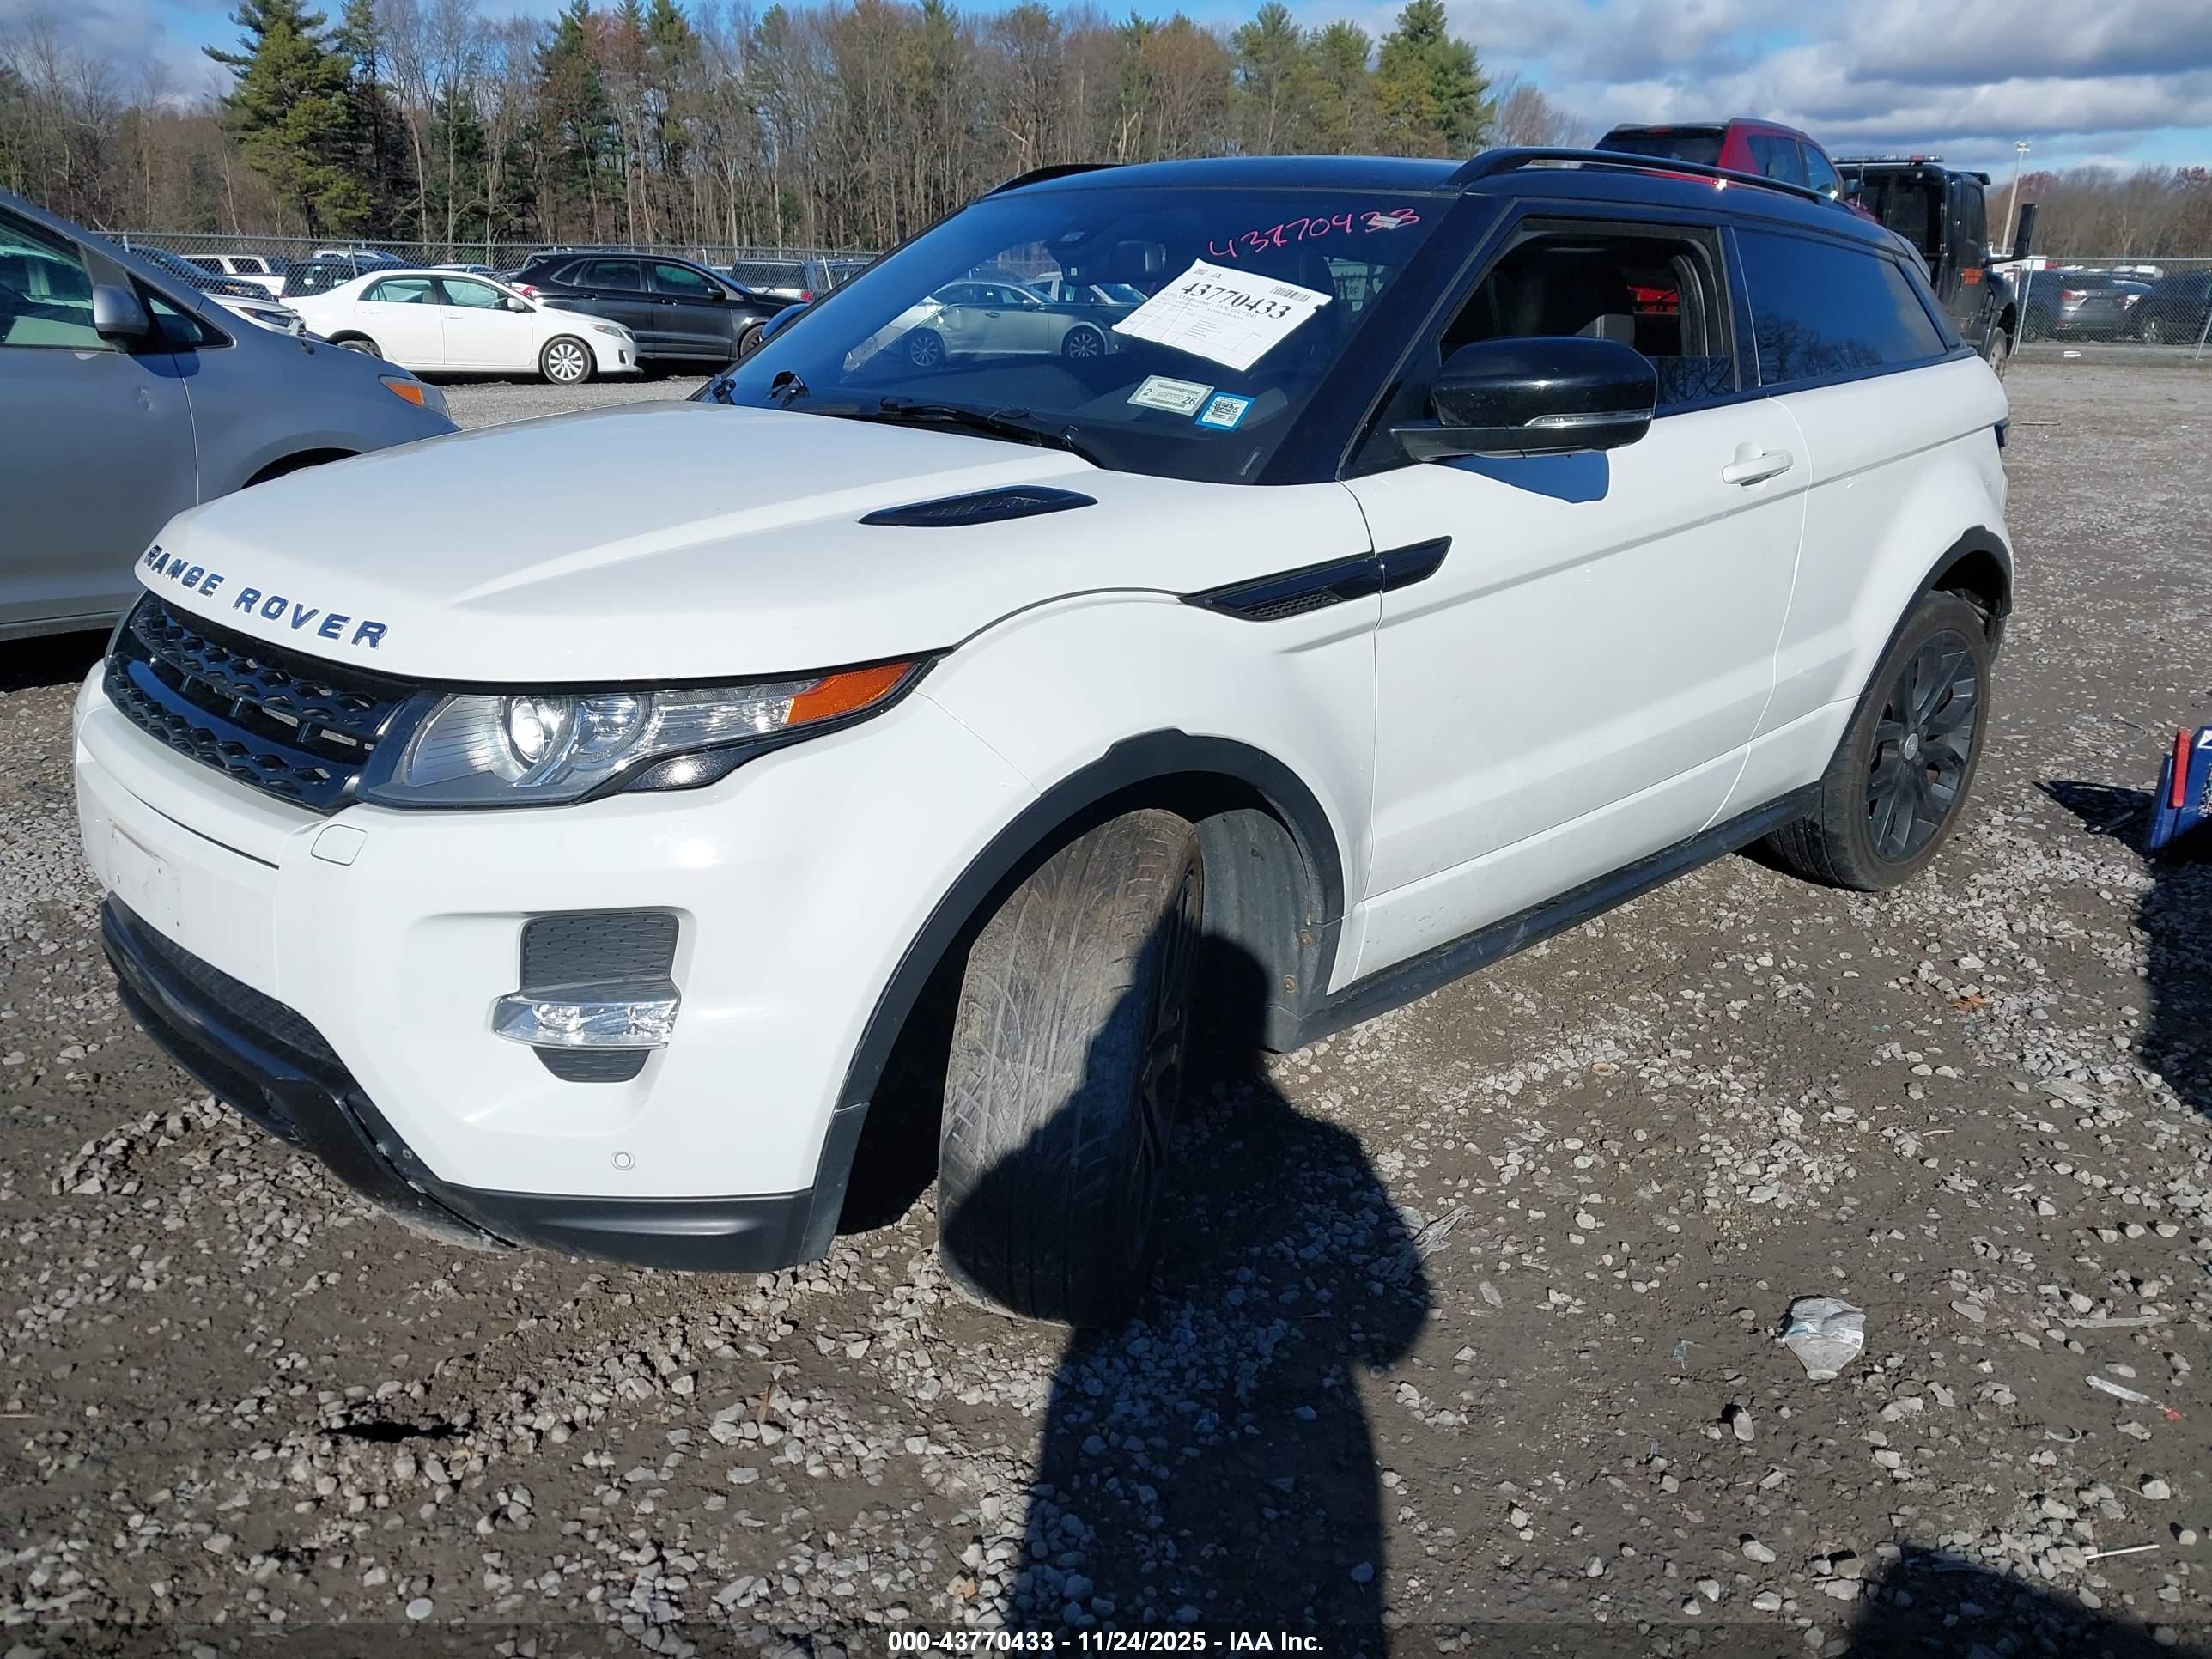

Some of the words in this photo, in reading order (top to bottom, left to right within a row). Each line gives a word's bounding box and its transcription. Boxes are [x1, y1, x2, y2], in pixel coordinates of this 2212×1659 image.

[1181, 282, 1291, 319] 43770433
[1182, 396, 1197, 406] 26
[143, 544, 225, 599] RANGE
[232, 587, 389, 649] ROVER
